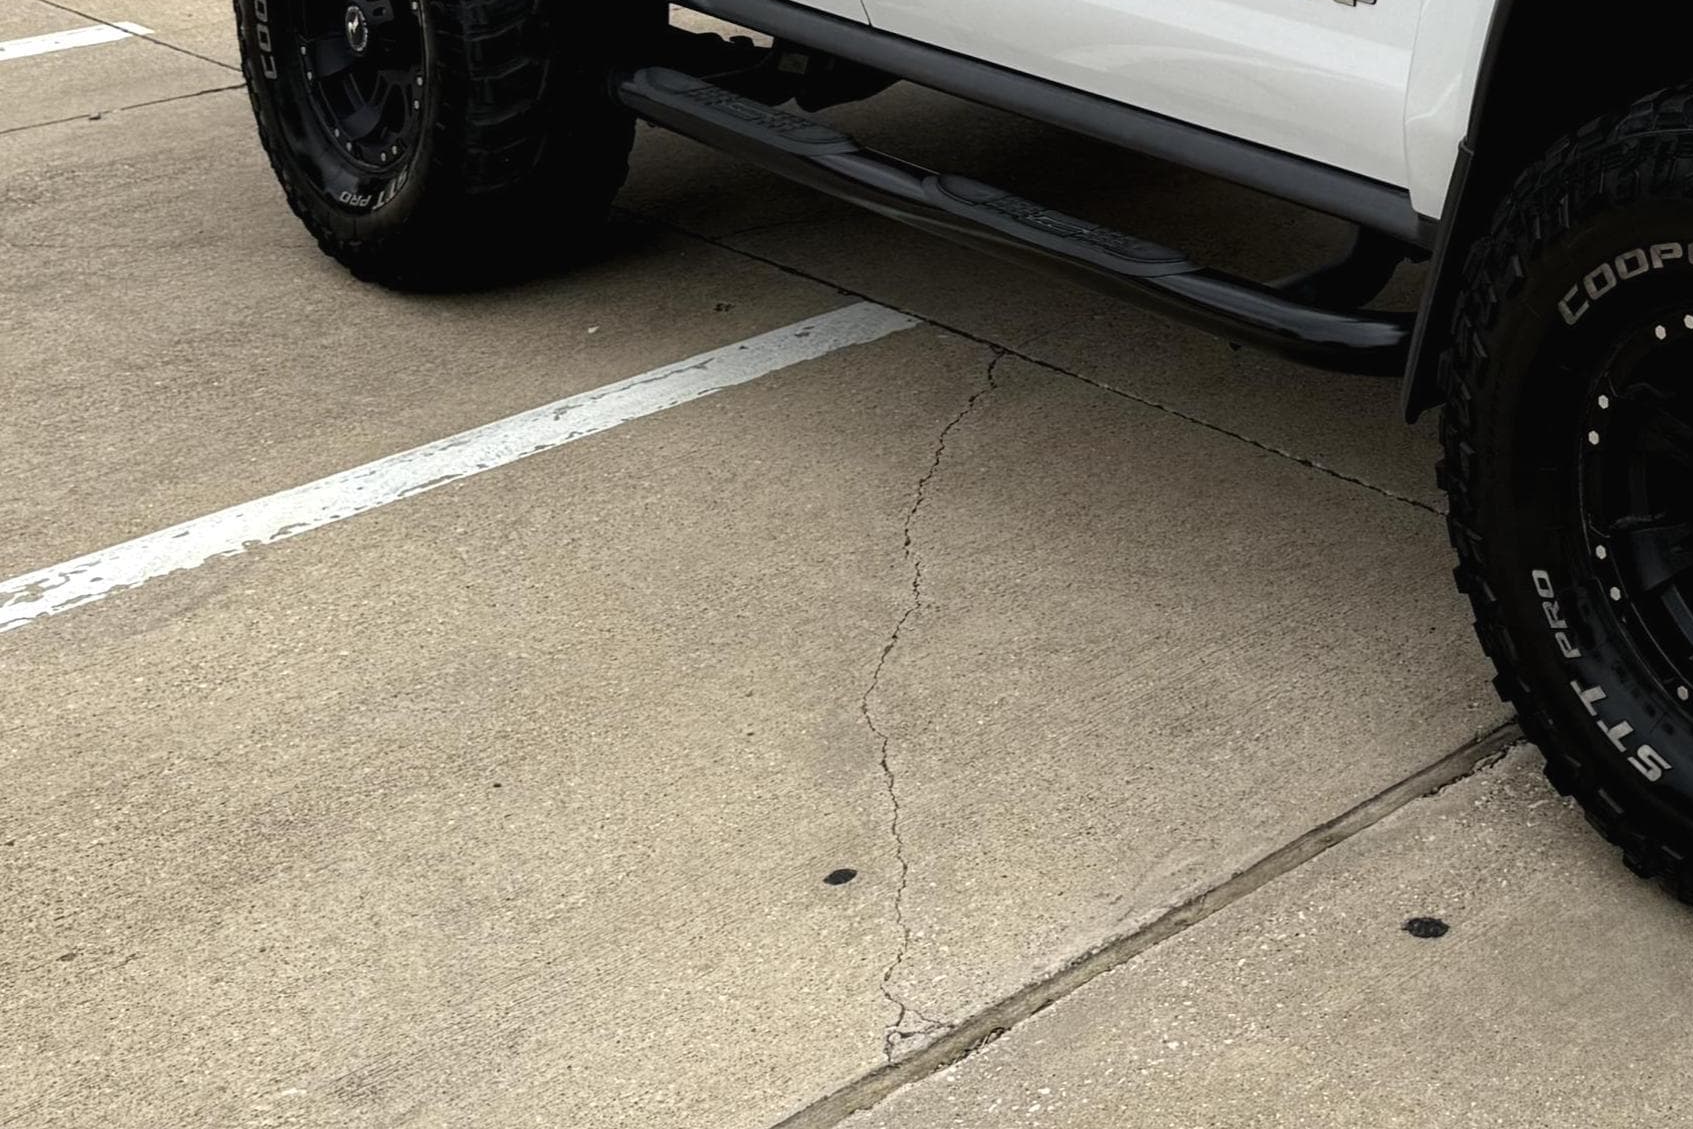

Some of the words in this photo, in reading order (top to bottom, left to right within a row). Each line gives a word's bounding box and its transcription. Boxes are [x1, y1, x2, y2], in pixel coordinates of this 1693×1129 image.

[340, 191, 372, 207] PRO
[1532, 570, 1582, 658] PRO
[1570, 680, 1672, 782] STT
